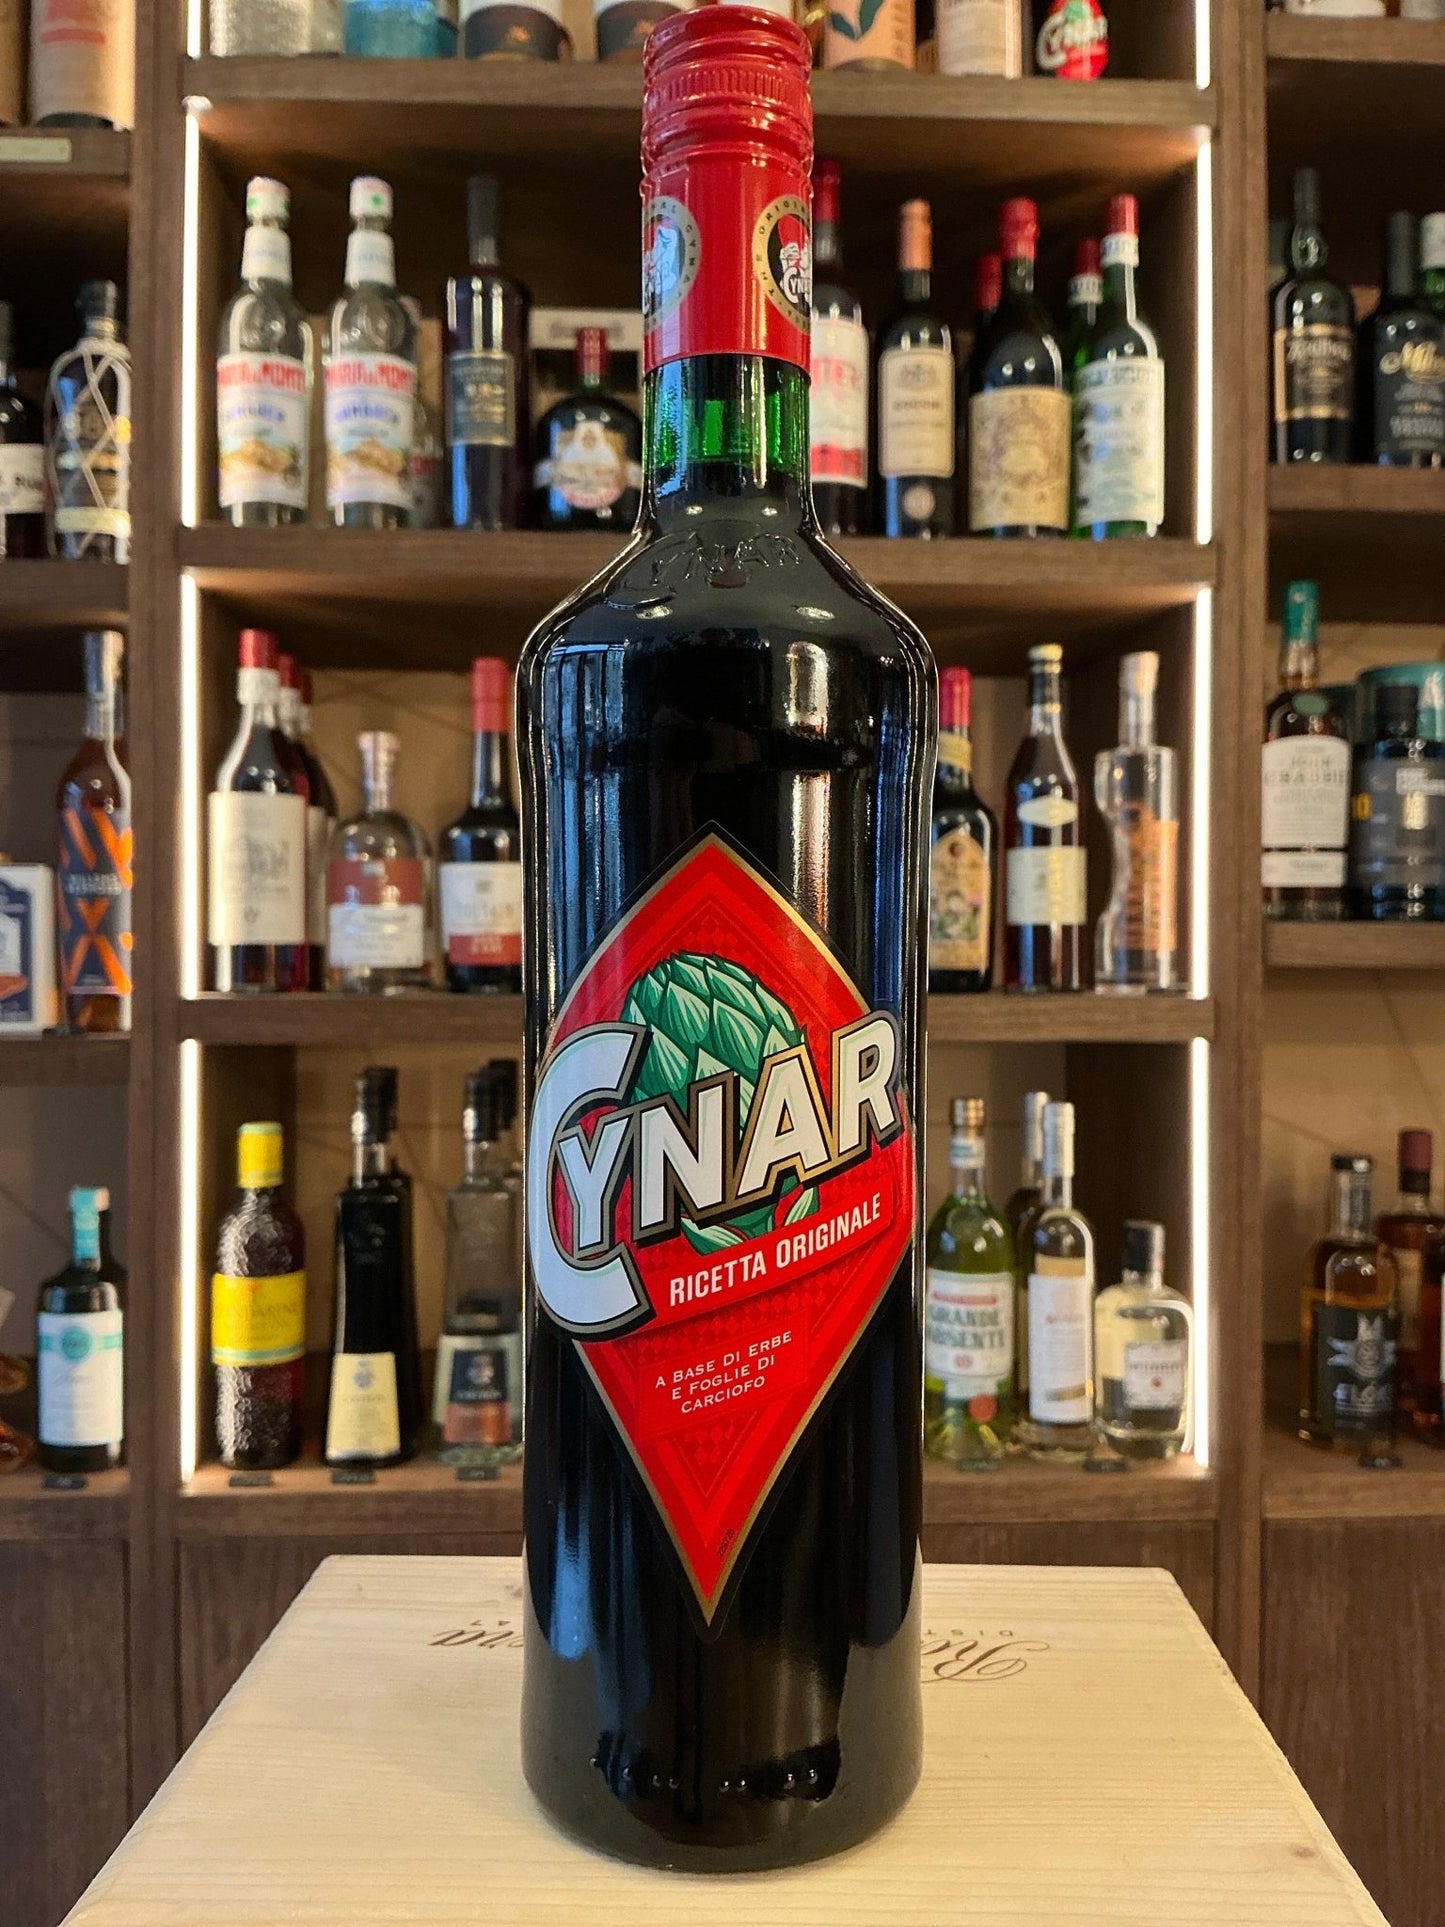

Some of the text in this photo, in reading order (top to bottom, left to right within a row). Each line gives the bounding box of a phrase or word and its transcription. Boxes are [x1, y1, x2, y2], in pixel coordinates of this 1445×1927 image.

[528, 1011, 905, 1335] CYNAR
[669, 1192, 882, 1307] RICETTA ORIGINALE
[655, 1330, 793, 1389] A BASE DI ERBE
[671, 1354, 775, 1401] E FOGLIE DI
[680, 1375, 766, 1414] CARCIOFO
